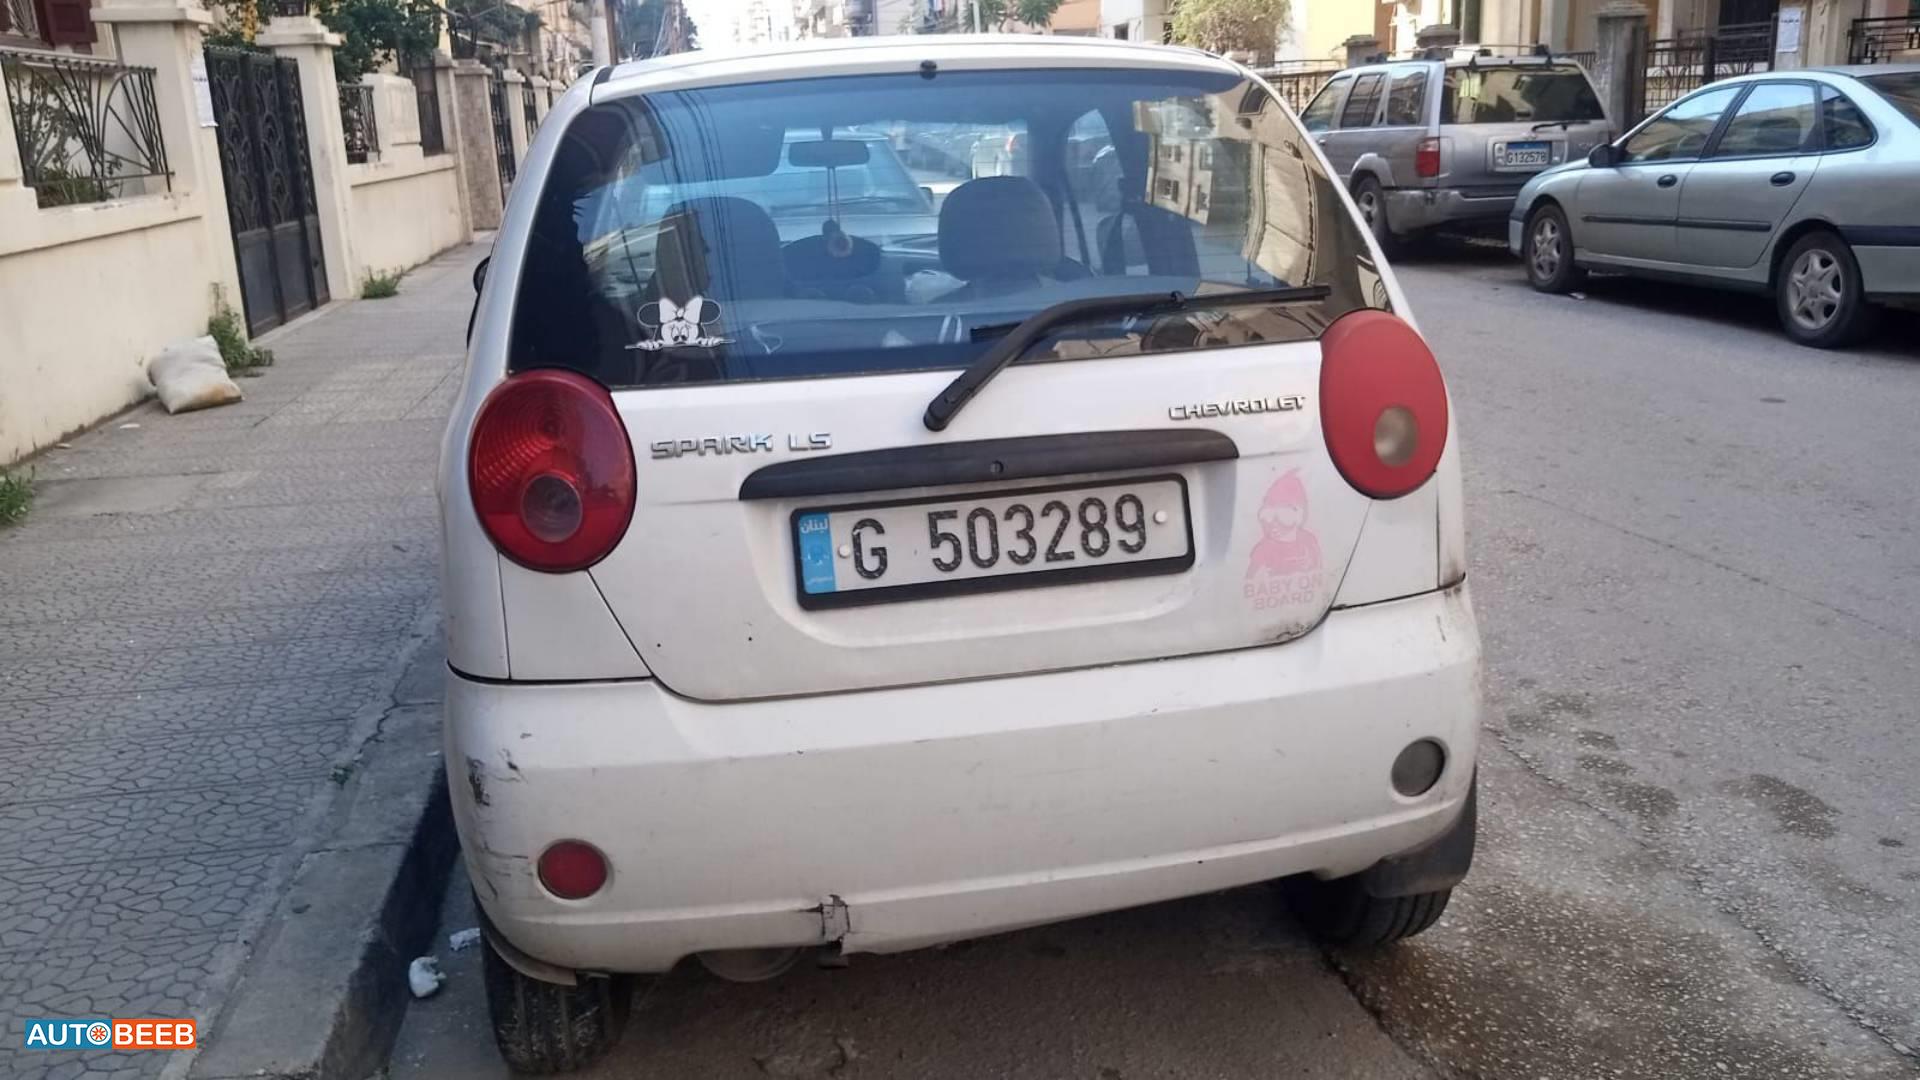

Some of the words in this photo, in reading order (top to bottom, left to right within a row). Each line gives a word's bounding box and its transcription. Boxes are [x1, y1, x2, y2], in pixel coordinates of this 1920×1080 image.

[1168, 396, 1306, 420] CHEVROLET
[651, 432, 774, 459] SPARK
[788, 431, 832, 451] LS
[800, 518, 829, 534] لبنان
[852, 518, 888, 580] G
[926, 493, 1147, 573] 503289
[1244, 580, 1292, 599] BABY
[1298, 575, 1325, 592] ON
[1254, 591, 1314, 610] BOARD
